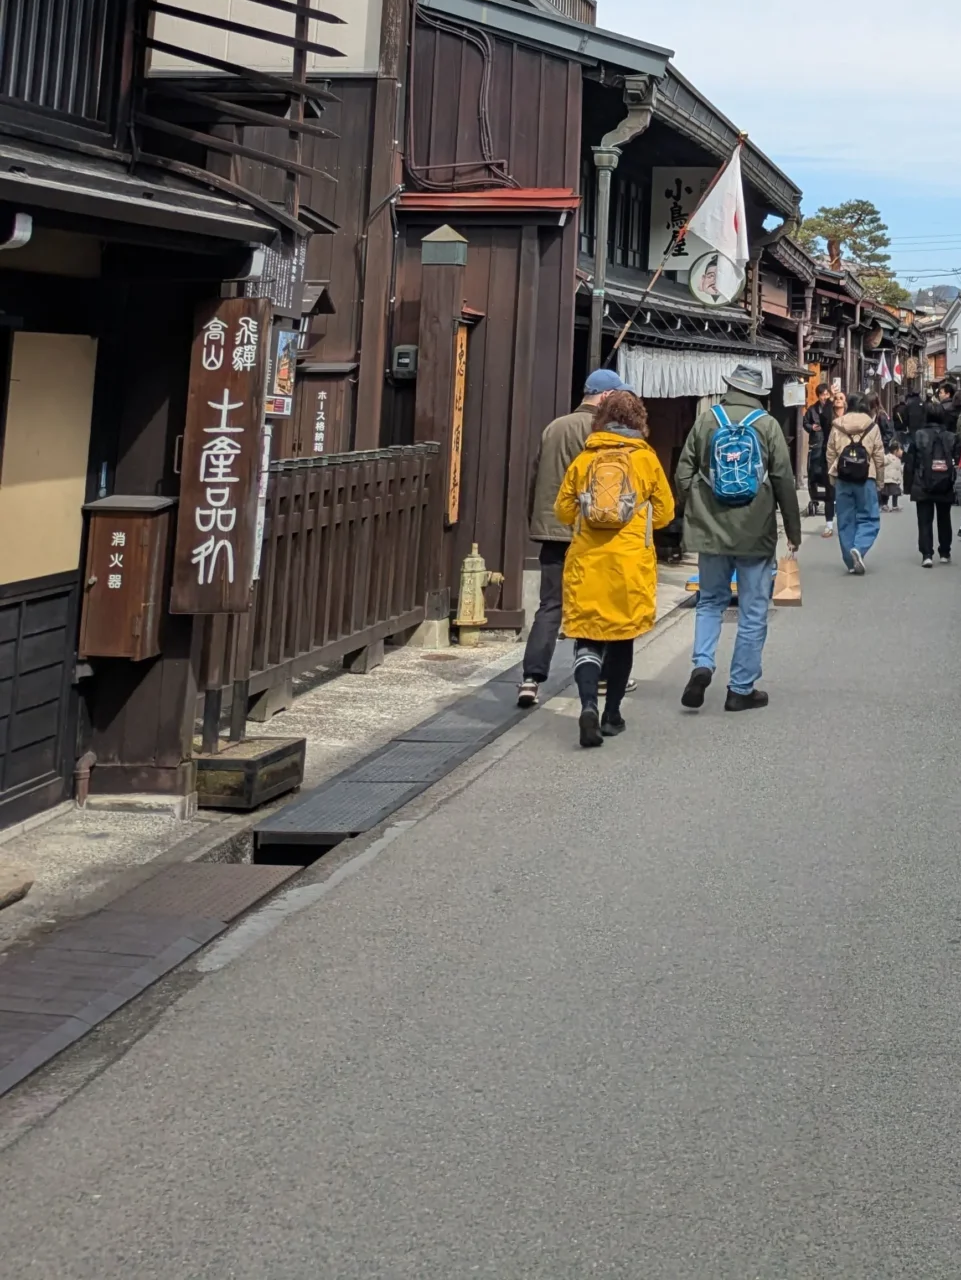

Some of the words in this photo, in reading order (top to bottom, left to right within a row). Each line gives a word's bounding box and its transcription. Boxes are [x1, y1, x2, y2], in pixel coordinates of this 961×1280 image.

[202, 316, 229, 371] 高山
[313, 391, 327, 452] ホース格納箱
[107, 531, 126, 589] 消火器
